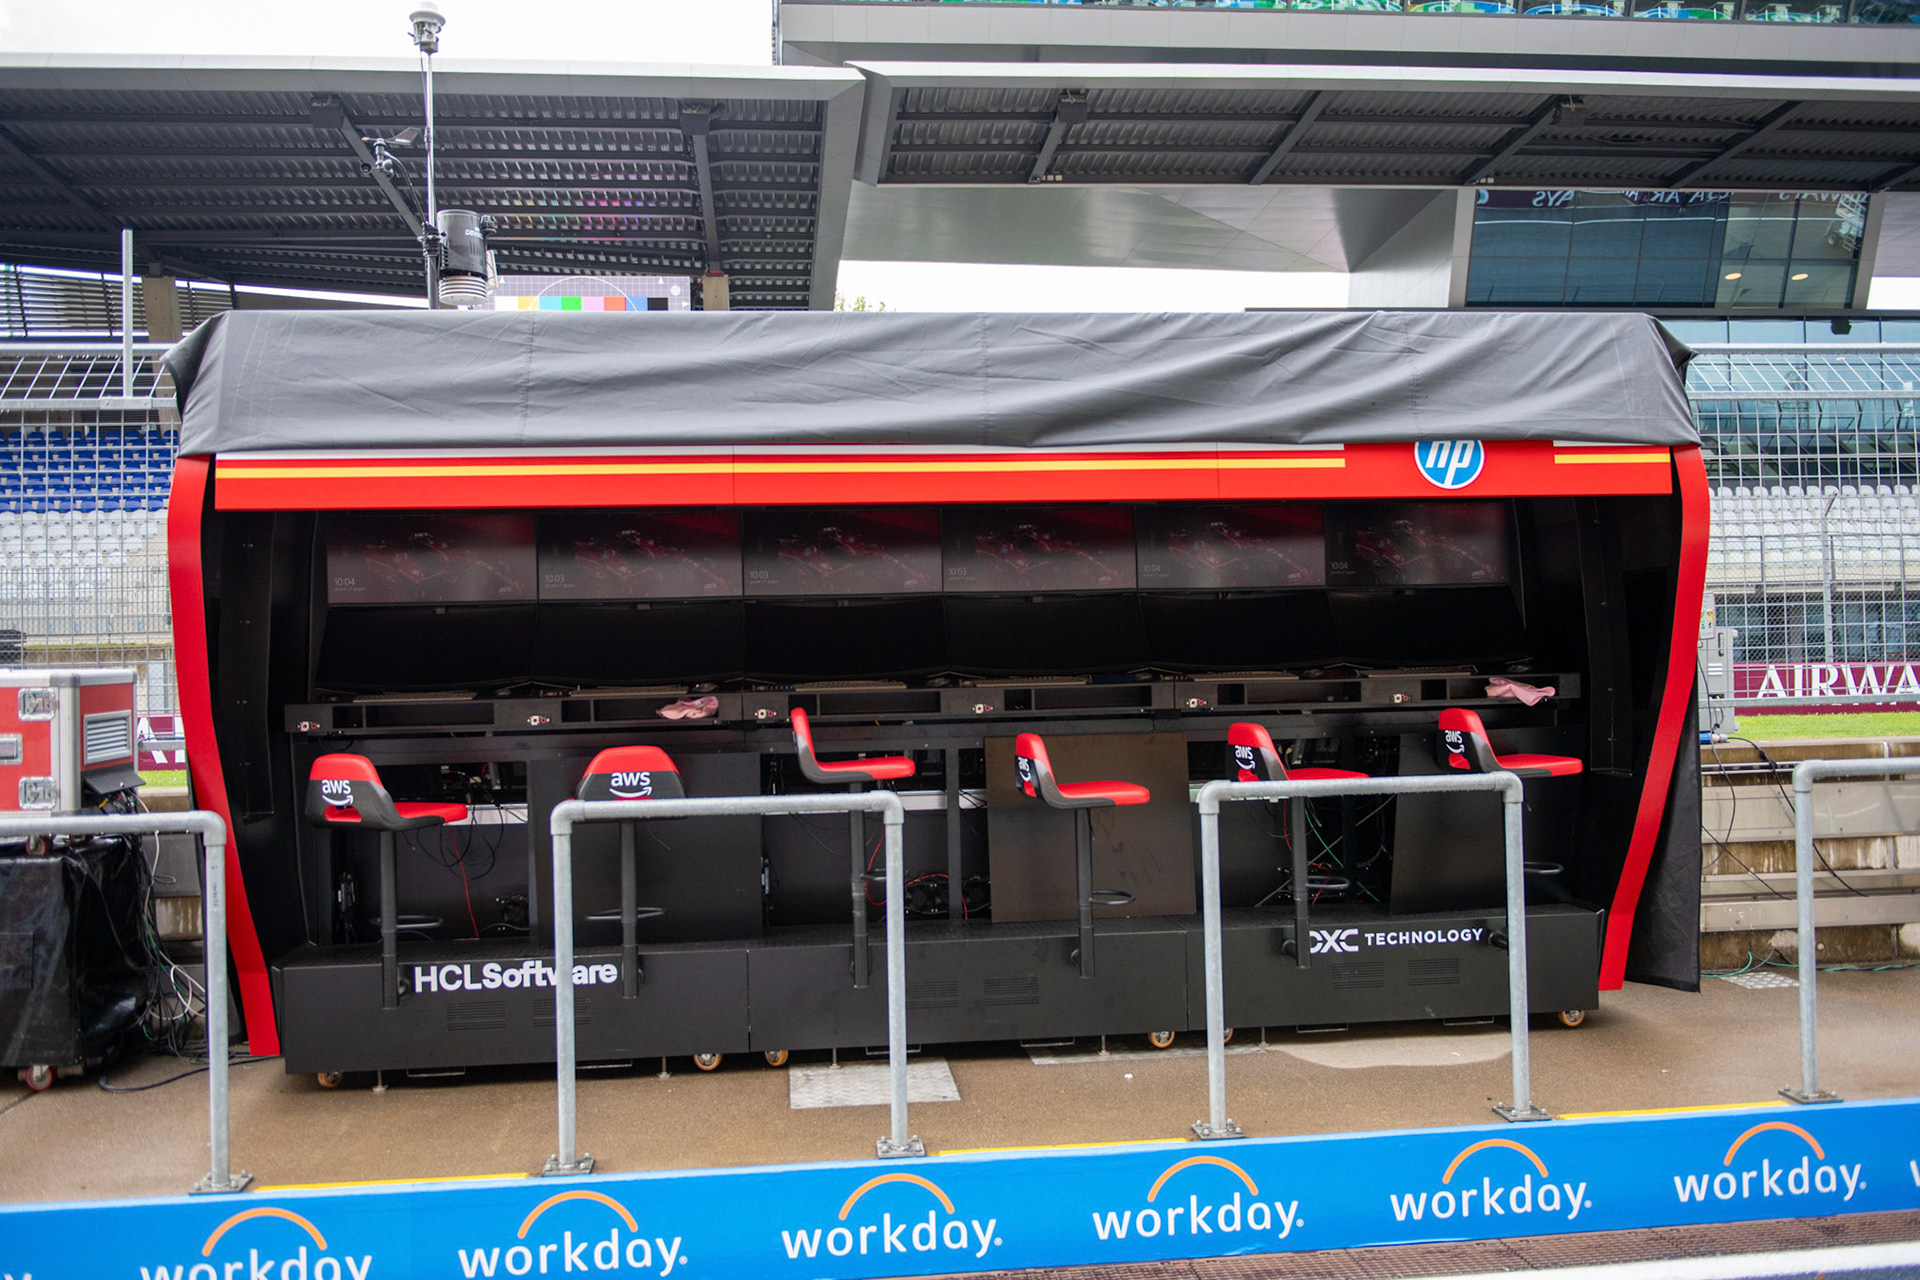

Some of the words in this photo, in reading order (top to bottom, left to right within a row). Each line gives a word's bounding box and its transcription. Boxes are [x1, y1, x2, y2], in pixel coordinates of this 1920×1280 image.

[334, 577, 355, 586] 10:04
[1444, 729, 1463, 744] aws
[1234, 744, 1254, 760] aws
[322, 779, 352, 795] aws
[610, 771, 651, 787] aws
[1365, 928, 1484, 946] TECHNOLOGY
